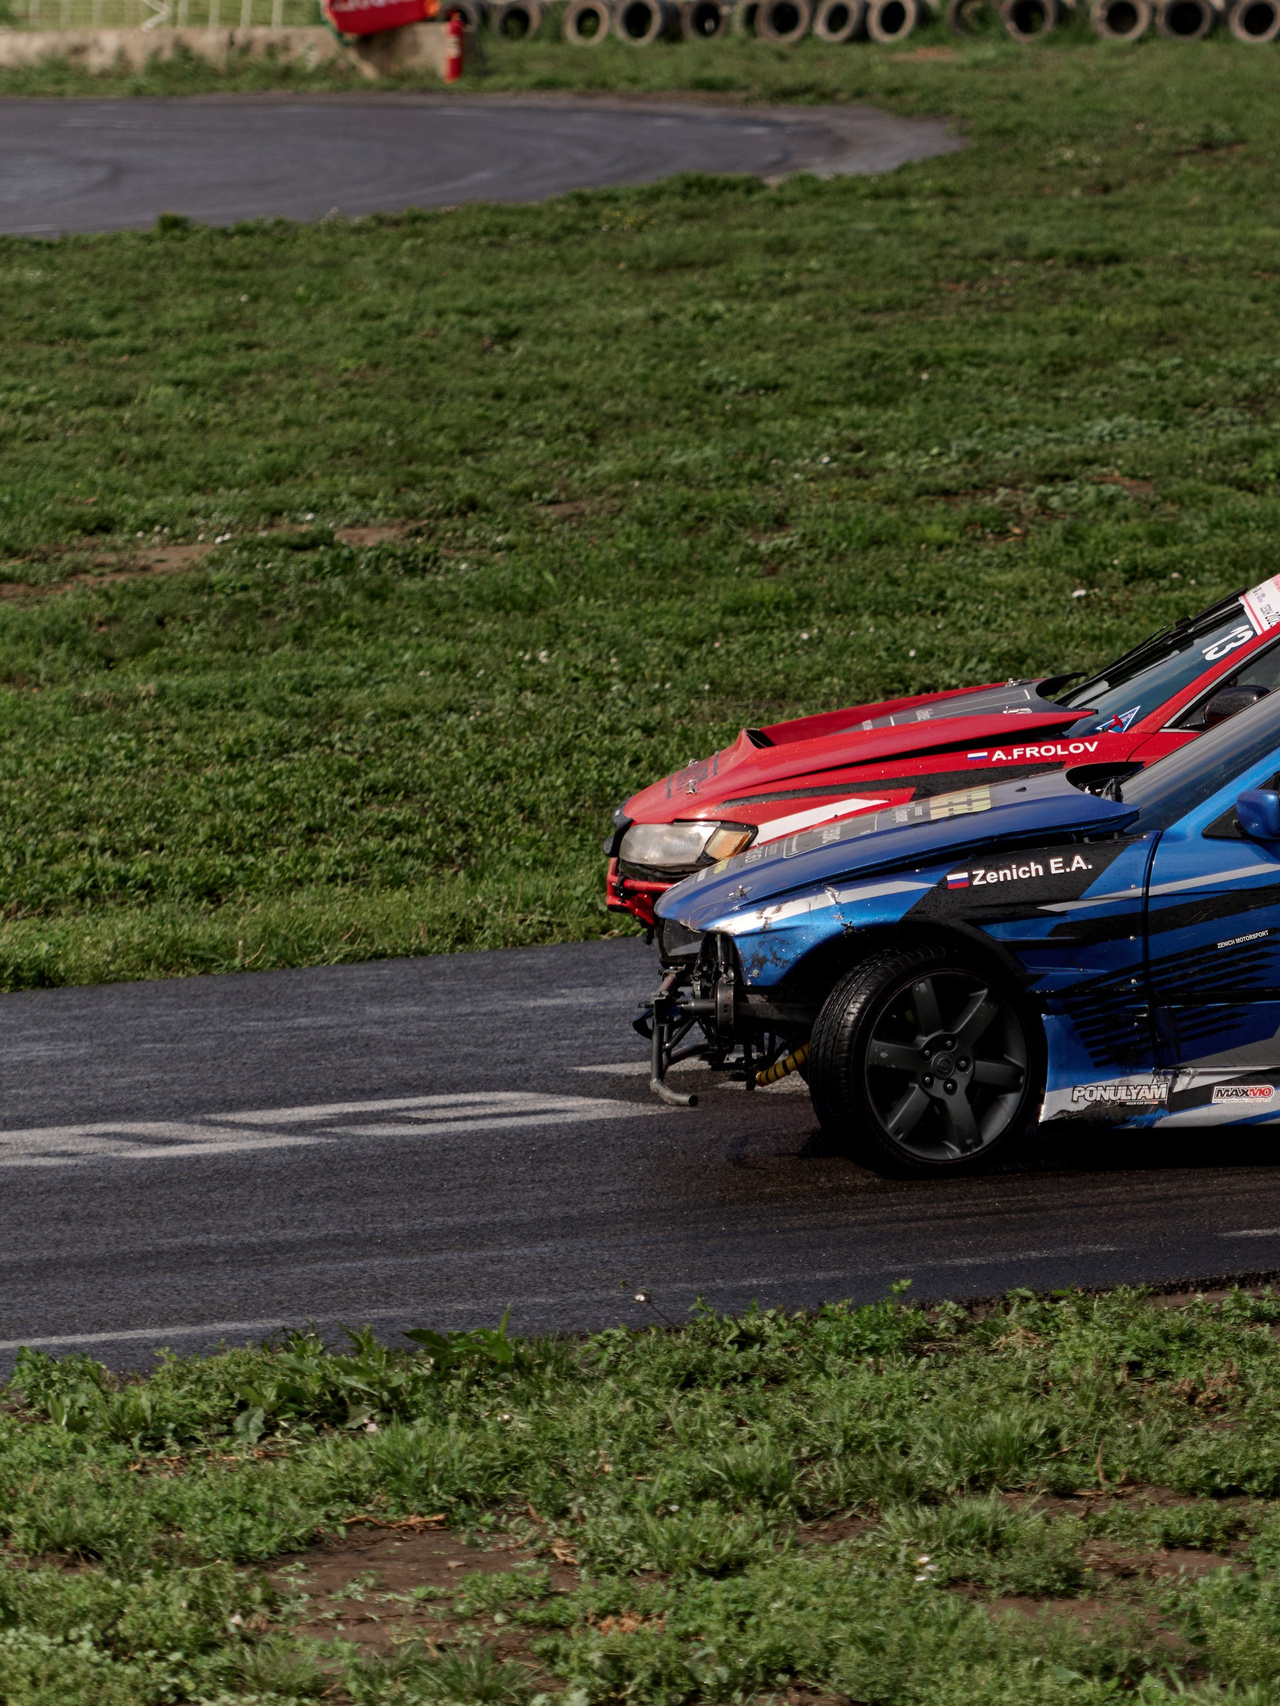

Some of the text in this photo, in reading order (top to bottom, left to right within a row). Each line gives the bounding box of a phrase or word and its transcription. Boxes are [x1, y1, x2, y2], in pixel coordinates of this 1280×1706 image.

[1202, 624, 1254, 661] 13
[991, 741, 1099, 762] A.FROLOV
[972, 855, 1093, 886] Zenich E.A.
[1073, 1083, 1168, 1102] PONULYAM
